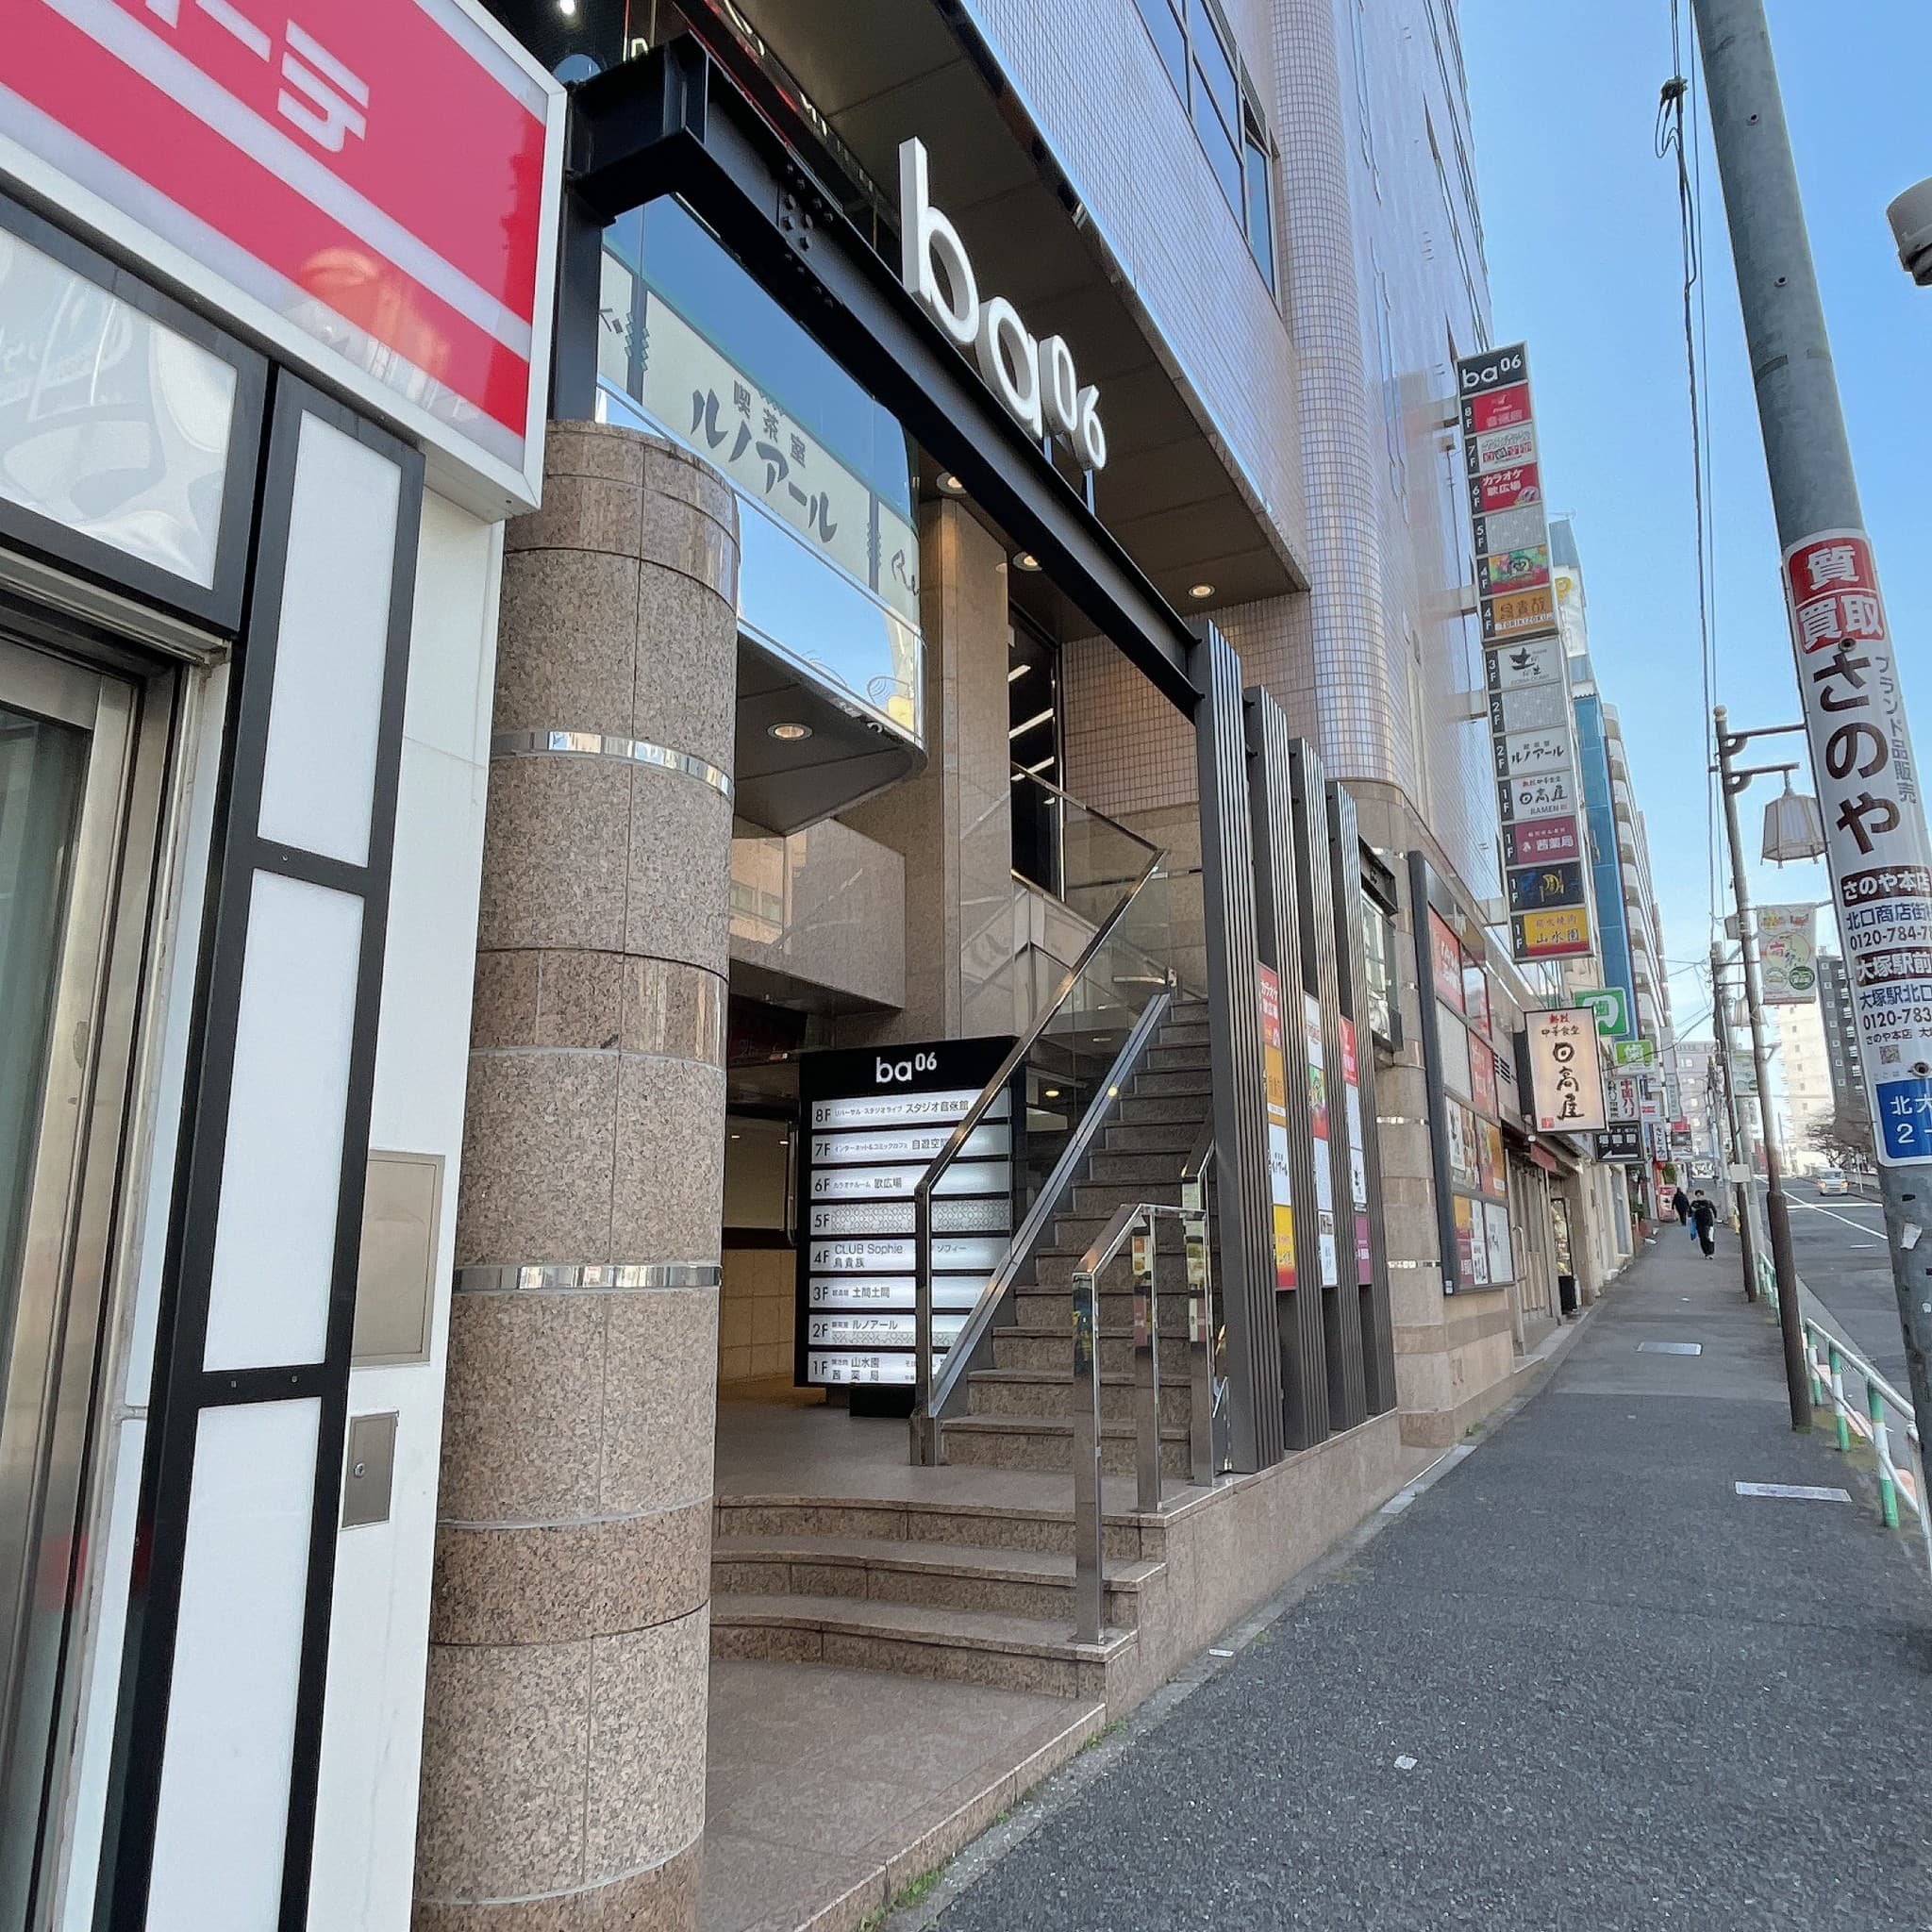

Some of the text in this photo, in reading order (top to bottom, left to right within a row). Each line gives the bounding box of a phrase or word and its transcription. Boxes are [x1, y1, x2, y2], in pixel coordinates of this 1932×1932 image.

[733, 379, 807, 469] 喫茶室
[691, 388, 838, 543] ルノアール
[1482, 468, 1524, 487] カラオケ
[1806, 546, 1860, 591] 質
[1802, 593, 1885, 650] 買取
[1511, 745, 1565, 764] ルノアール
[1813, 647, 1901, 855] さのや
[1842, 871, 1932, 901] さのや本店
[1846, 901, 1932, 931] 北口商店街
[874, 1051, 938, 1084] ba06
[815, 1108, 831, 1123] 8F
[815, 1142, 831, 1157] 7F
[814, 1177, 830, 1192] 6F
[814, 1213, 830, 1228] 5F
[813, 1242, 904, 1264] 4F CLUB Sophie
[813, 1286, 829, 1301] 3F
[852, 1287, 891, 1299] 土間土間
[812, 1323, 829, 1338] 2F
[852, 1320, 899, 1330] ルノアール
[812, 1360, 829, 1375] 1F
[851, 1357, 880, 1369] 山水園
